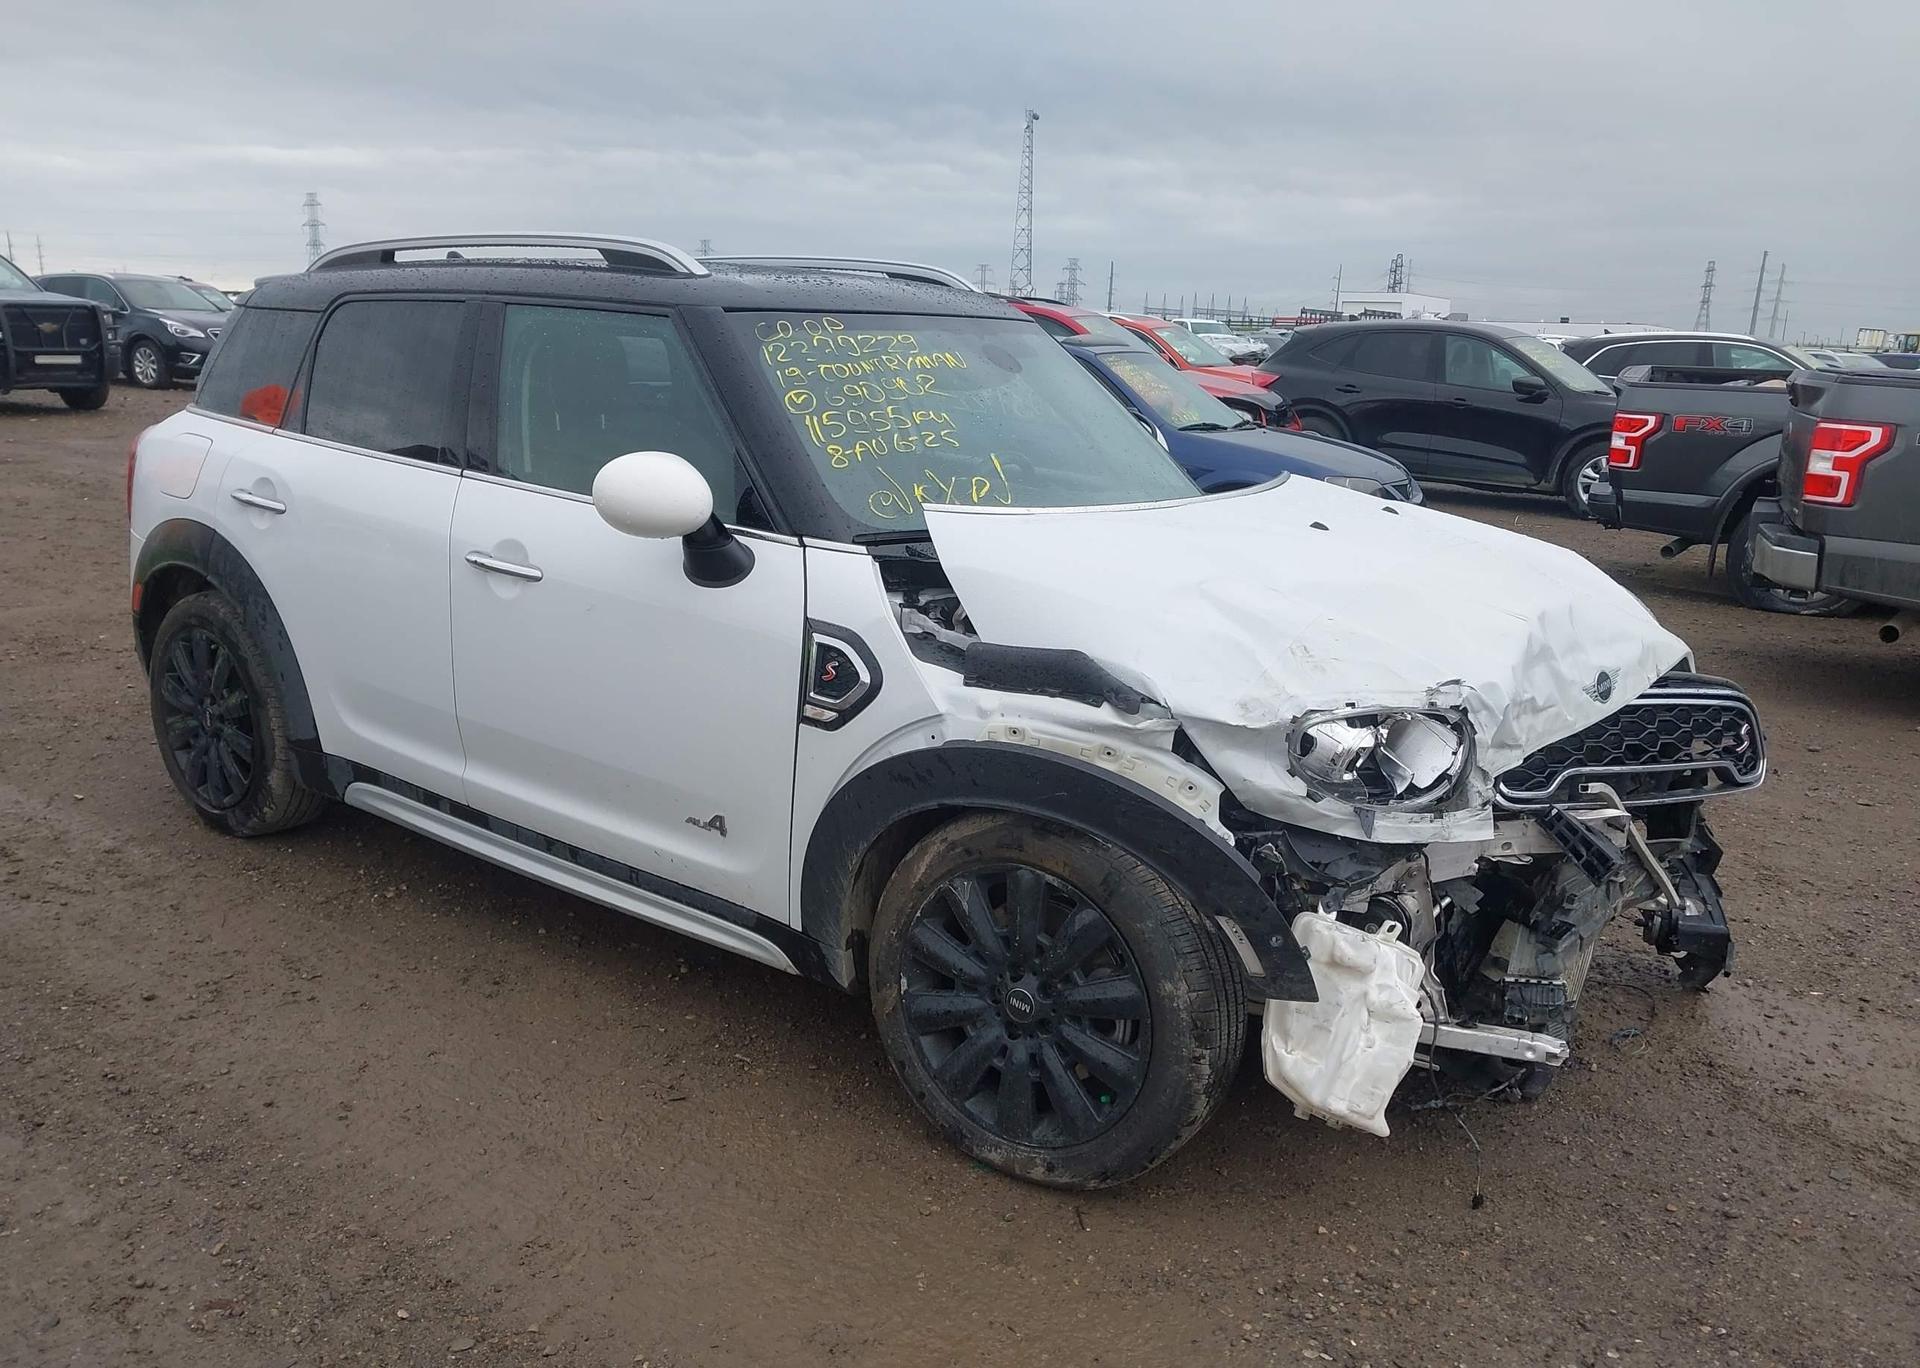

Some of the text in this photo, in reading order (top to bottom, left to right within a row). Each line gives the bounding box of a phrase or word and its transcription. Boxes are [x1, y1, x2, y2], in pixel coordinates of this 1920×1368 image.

[1672, 415, 1753, 434] FX4
[821, 661, 839, 681] S
[1009, 997, 1031, 1013] MINI
